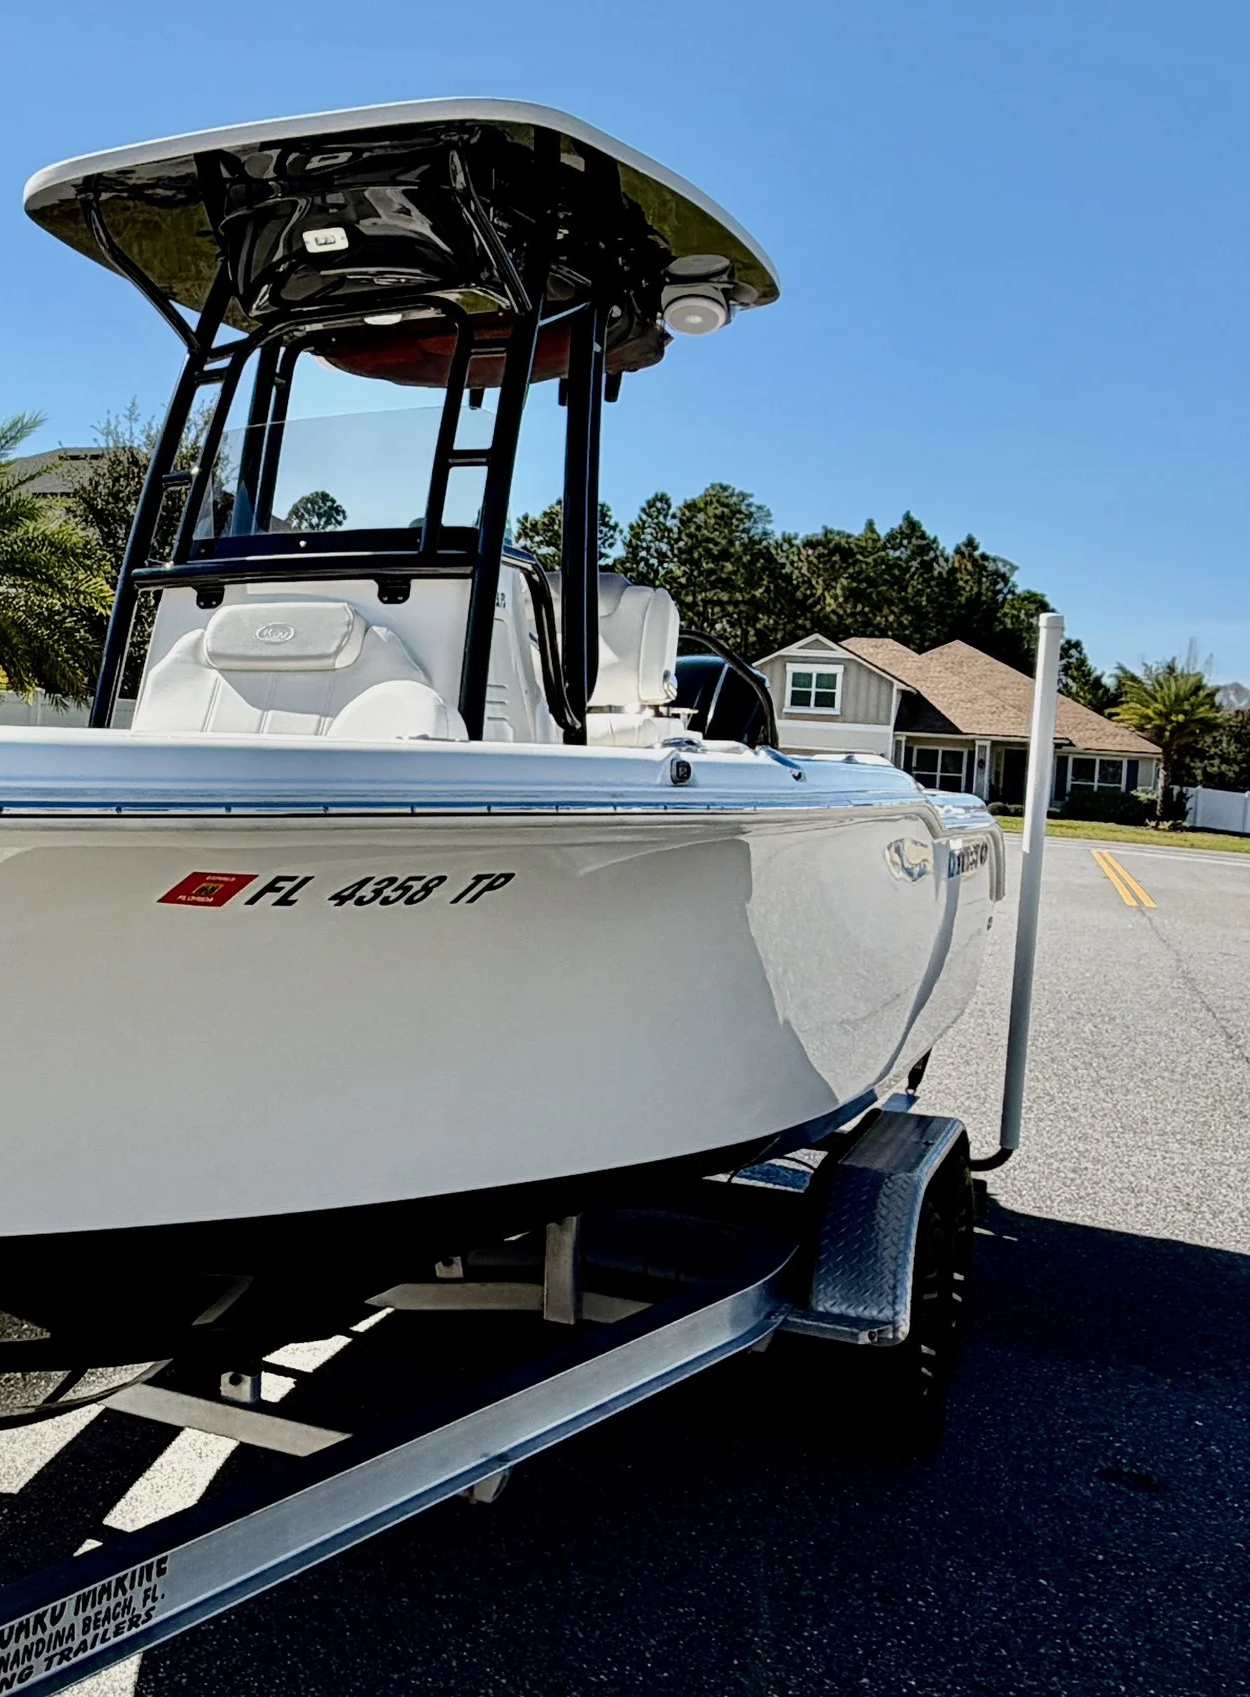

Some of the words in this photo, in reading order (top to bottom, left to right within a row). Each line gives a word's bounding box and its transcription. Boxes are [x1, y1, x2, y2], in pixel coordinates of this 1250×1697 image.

[244, 875, 316, 907] FL
[327, 874, 448, 907] 4358
[449, 872, 516, 904] TP
[81, 1595, 136, 1637] BEACH,
[141, 1583, 165, 1608] FL.
[43, 1605, 156, 1672] TRAILERS
